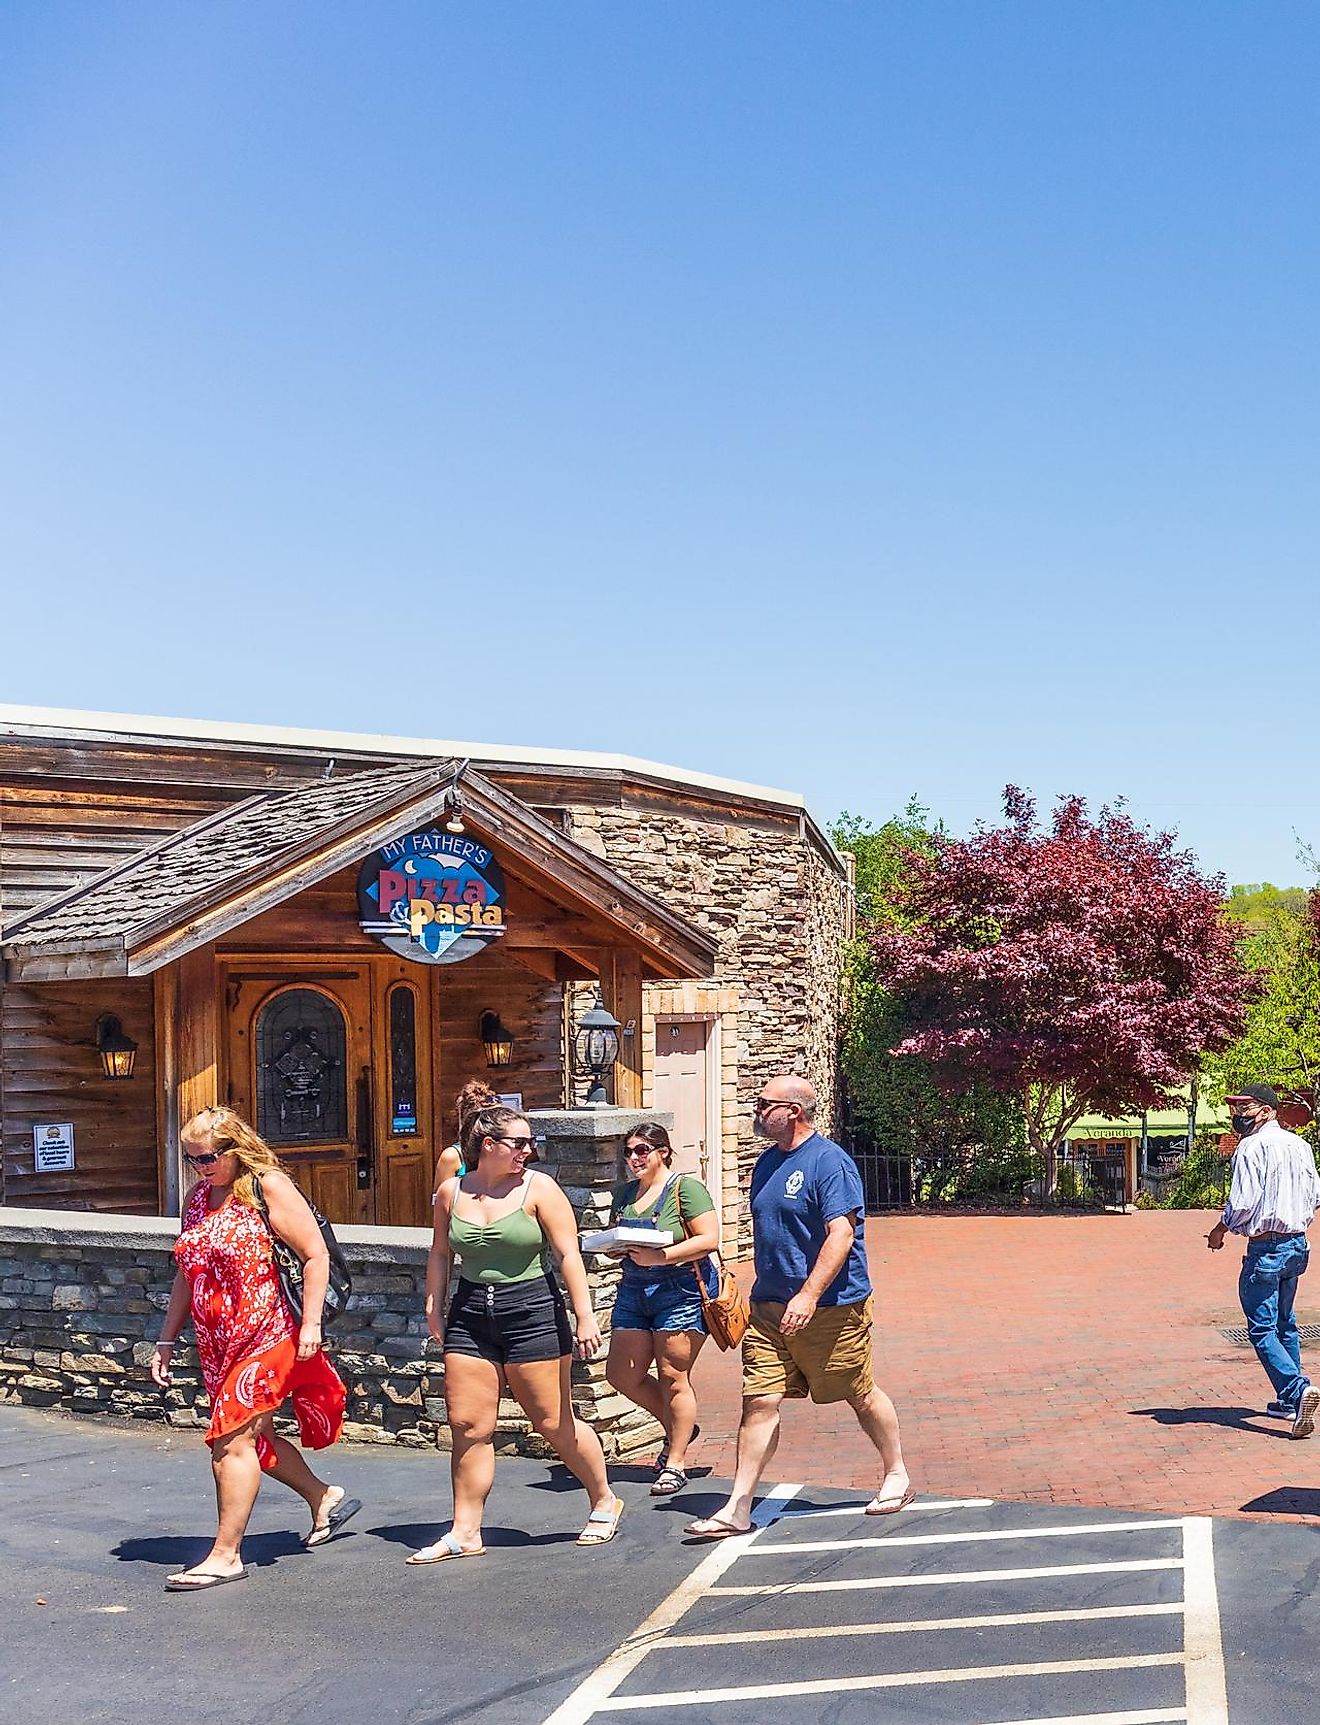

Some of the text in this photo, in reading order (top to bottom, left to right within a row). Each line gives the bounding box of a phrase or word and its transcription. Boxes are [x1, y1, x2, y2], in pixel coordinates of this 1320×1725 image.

[383, 835, 488, 864] MY FATHER'S
[379, 869, 487, 914] Pizza
[389, 900, 503, 937] & Pasta
[1083, 1129, 1133, 1138] Veranda
